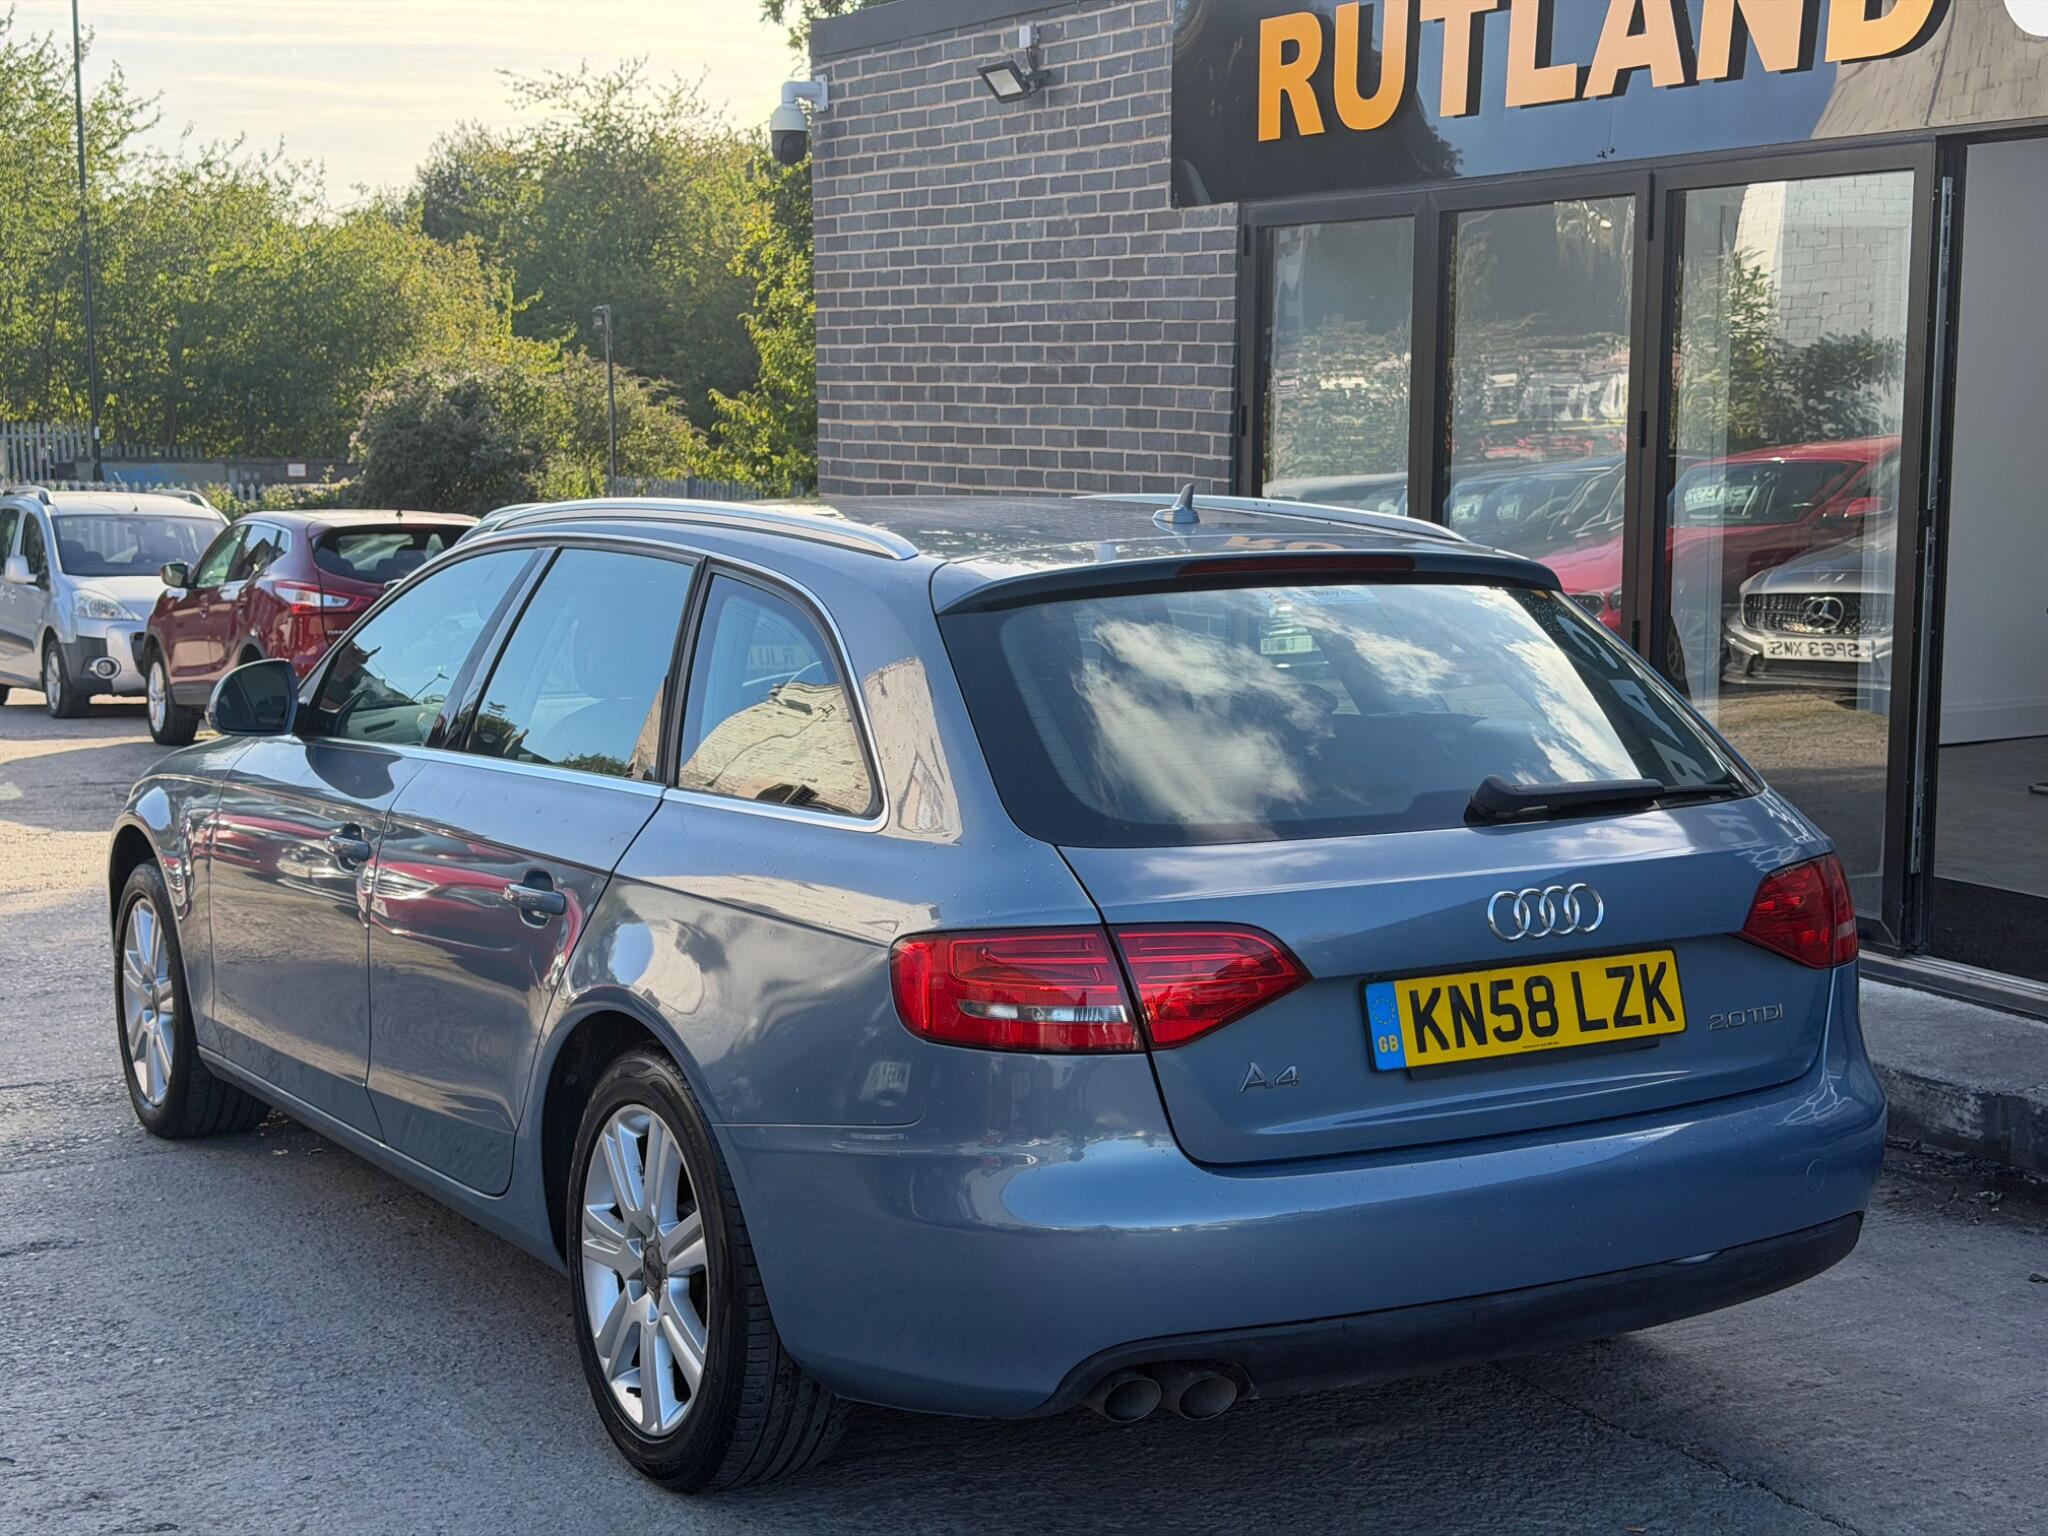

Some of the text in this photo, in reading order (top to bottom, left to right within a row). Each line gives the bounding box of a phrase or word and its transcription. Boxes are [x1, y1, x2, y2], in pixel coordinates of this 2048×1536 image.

[1408, 961, 1676, 1053] KN58 LZK
[1378, 1034, 1399, 1054] GB
[1239, 1062, 1301, 1093] A4
